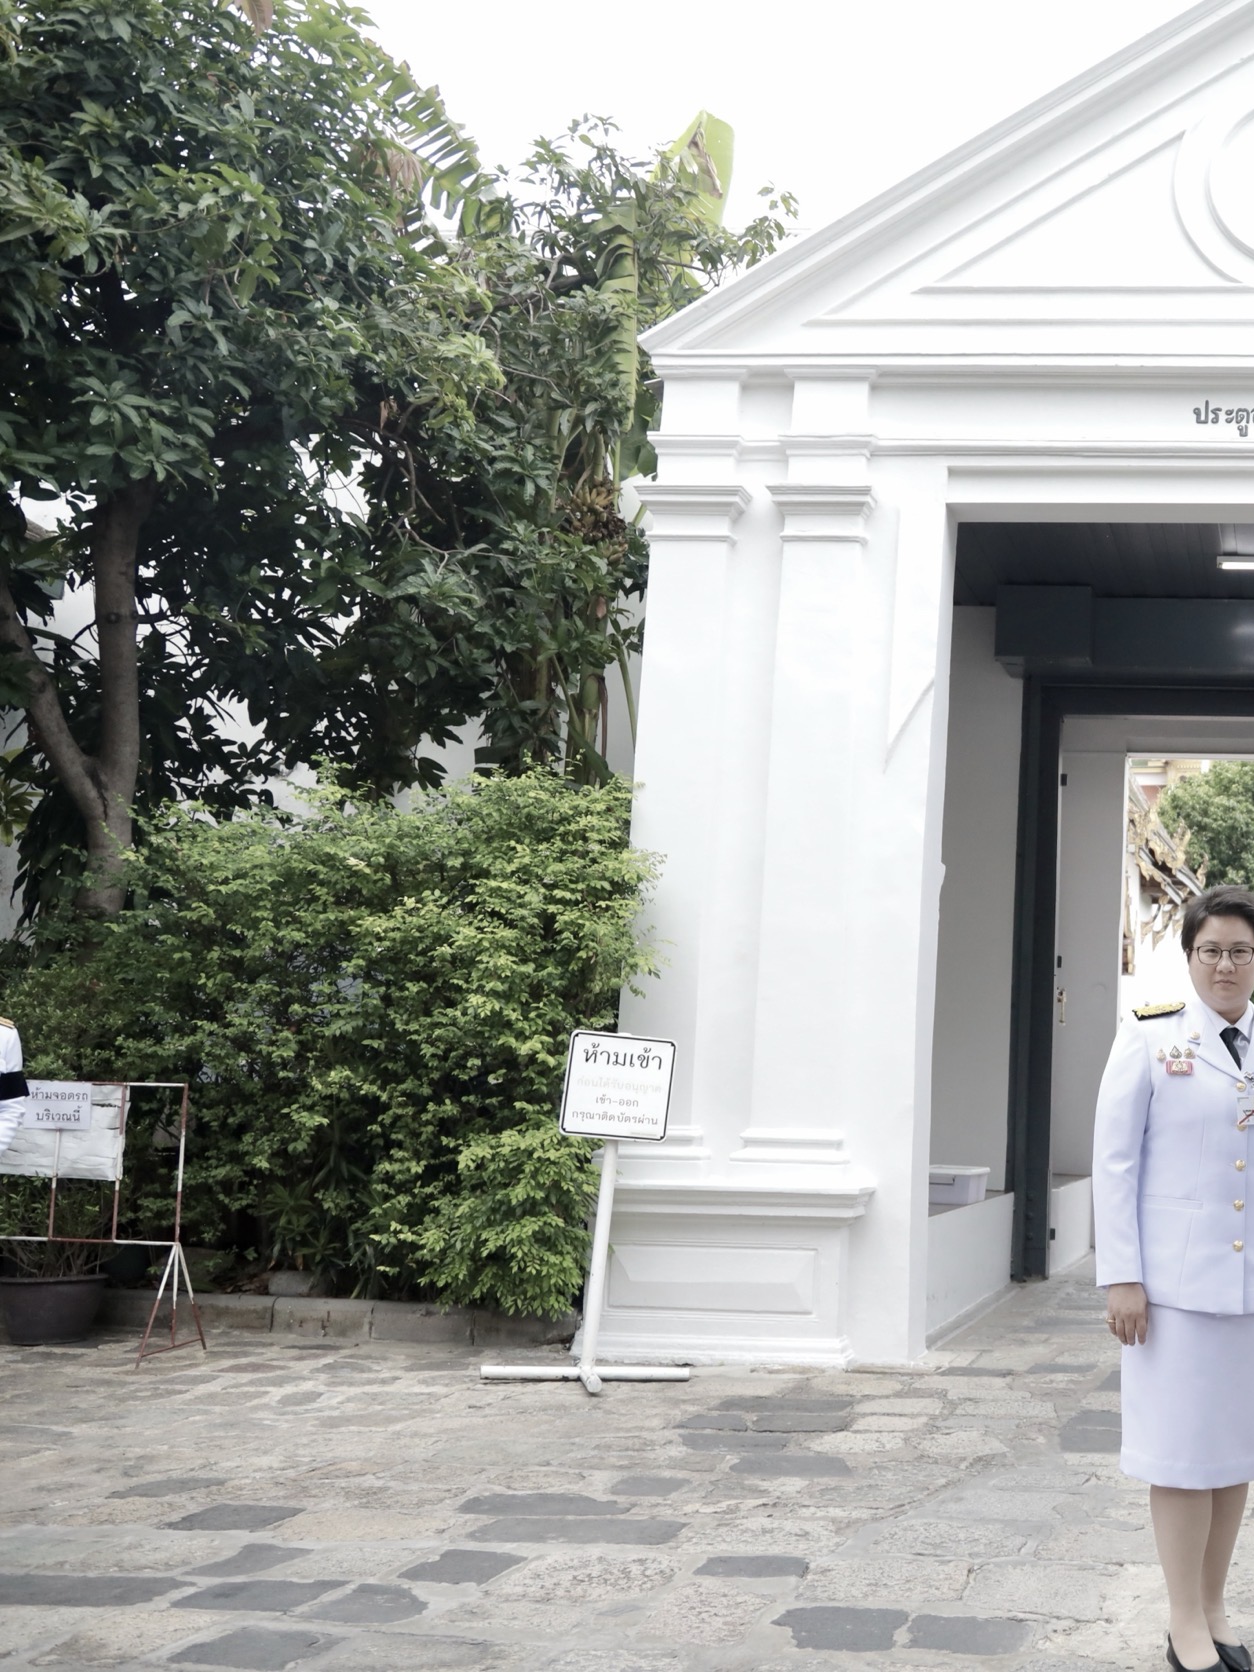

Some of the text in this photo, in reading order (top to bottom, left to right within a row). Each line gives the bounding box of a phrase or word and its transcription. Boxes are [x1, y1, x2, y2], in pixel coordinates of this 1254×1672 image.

[583, 1042, 662, 1070] ห้ามเข้า
[31, 1087, 88, 1101] ห้ามจอดรถ
[595, 1094, 639, 1108] เข้า-ออก
[36, 1106, 82, 1121] บริเวณนี้
[572, 1111, 658, 1126] กรุณาติดบัตรผ่าน
